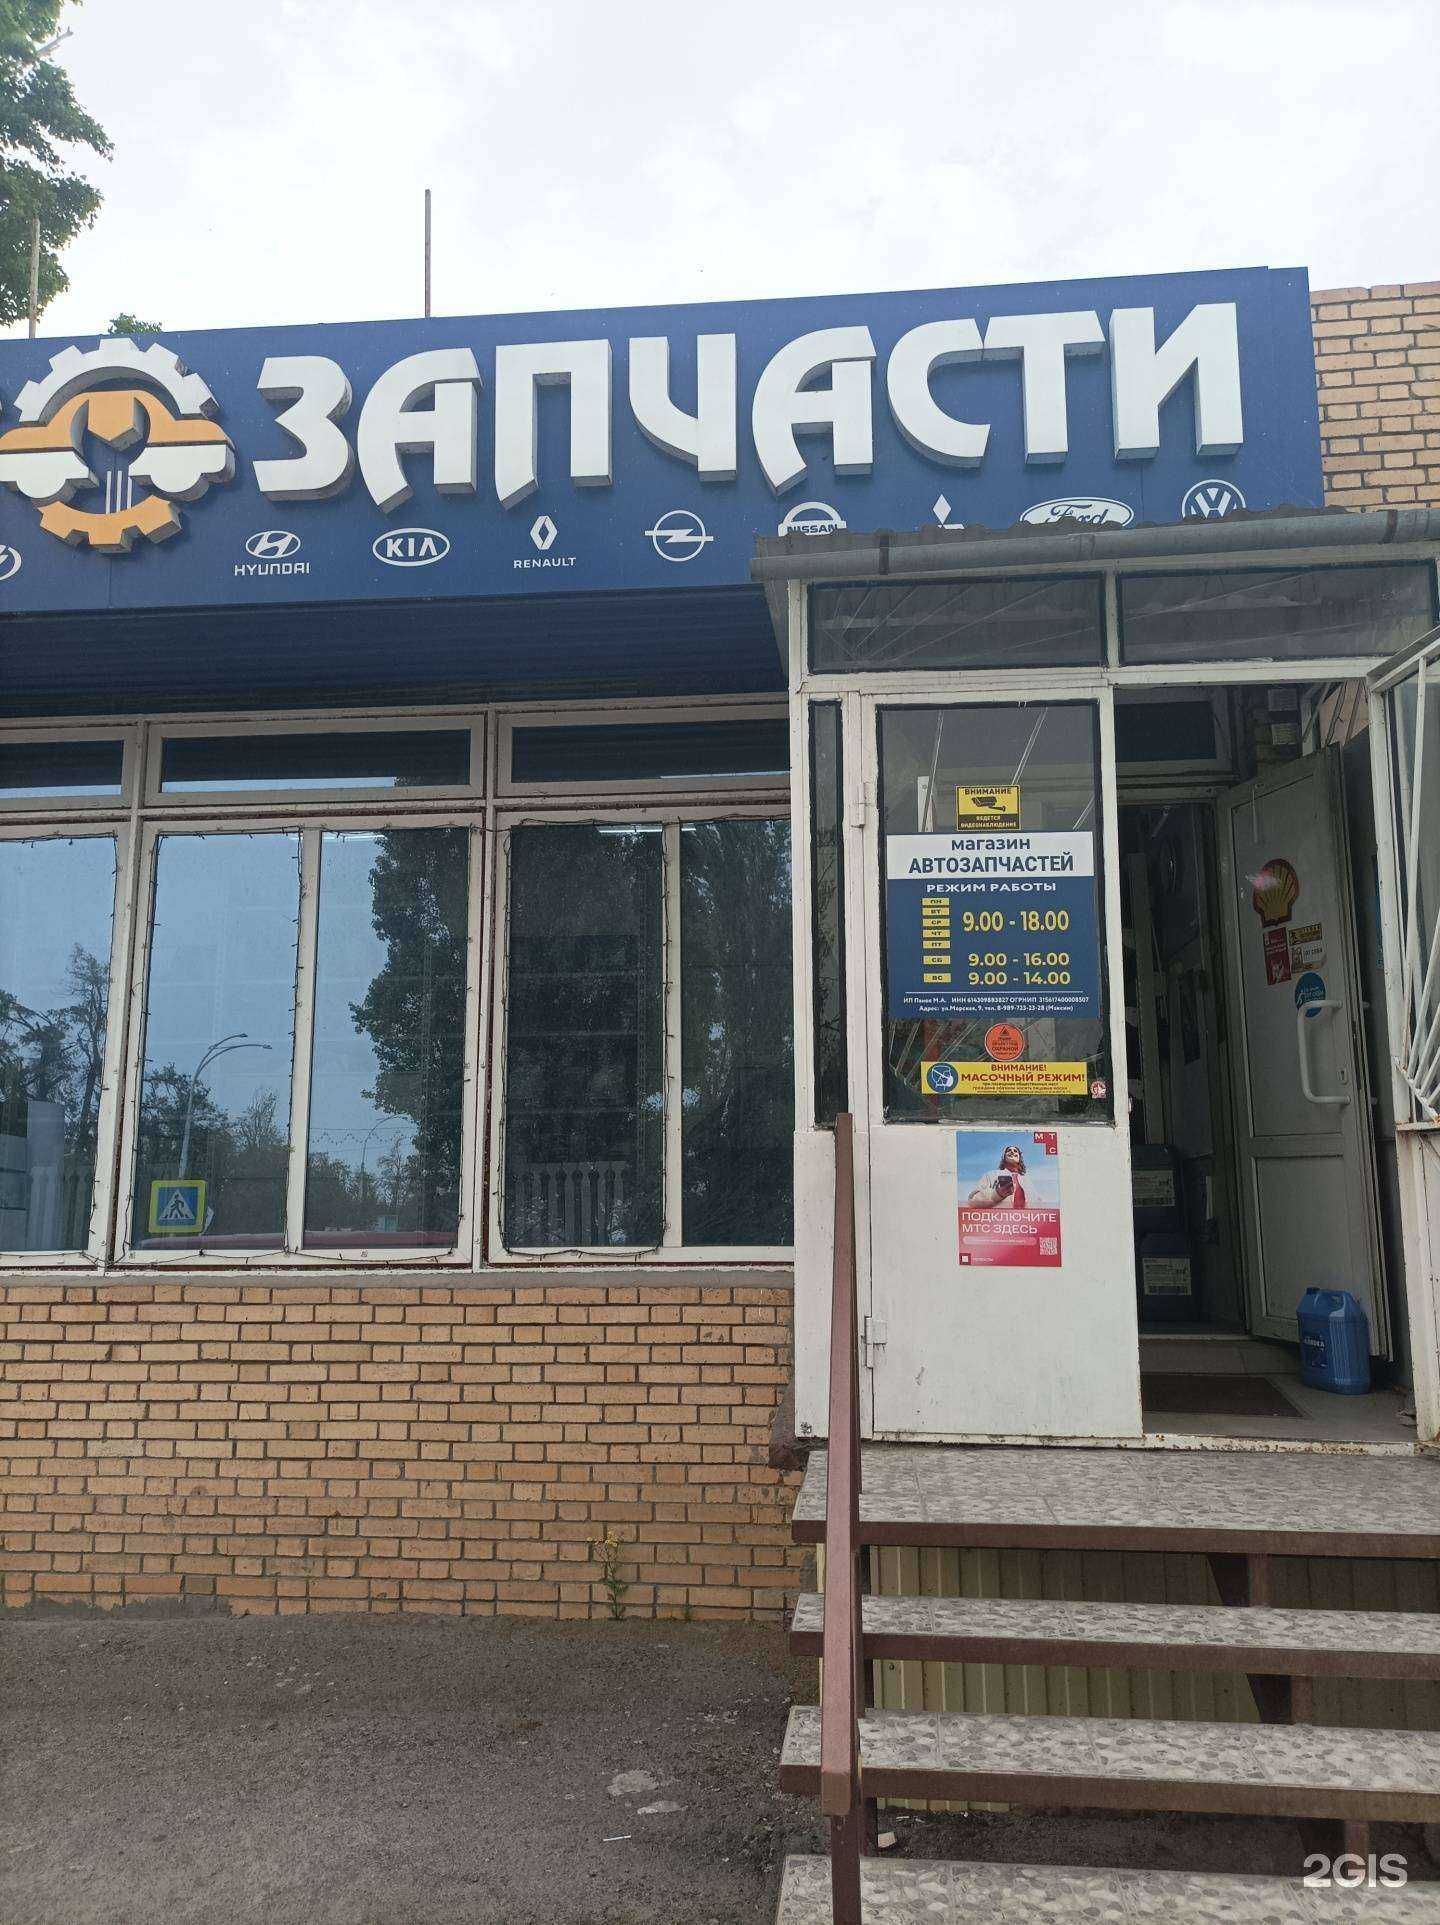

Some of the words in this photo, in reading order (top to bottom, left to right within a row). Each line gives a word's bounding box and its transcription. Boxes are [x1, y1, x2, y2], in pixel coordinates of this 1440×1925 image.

[252, 302, 1244, 508] ЗАПЧАСТИ
[386, 537, 438, 558] KIA
[513, 557, 576, 569] RENAULT
[234, 562, 310, 577] HYUNDAI
[964, 788, 1012, 796] ВНИМАНИЕ
[951, 838, 1031, 850] магазин
[908, 851, 1074, 874] АВТОЗАПЧАСТЕЙ
[926, 883, 986, 893] РЕЖИМ
[990, 882, 1057, 892] РАБОТЫ
[962, 911, 1004, 932] 9.00
[1020, 910, 1070, 931] 18.00
[968, 953, 1008, 967] 9.00
[1023, 952, 1070, 966] 16.00
[968, 972, 1008, 985] 9.00
[1023, 971, 1071, 985] 14.00
[990, 1064, 1047, 1072] ВНИМАНИЕ!
[961, 1071, 1034, 1082] МАСОЧНЫЙ
[1037, 1073, 1085, 1082] РЕЖИМ!
[962, 1211, 1057, 1223] ПОДКЛЮЧИТЕ
[962, 1223, 991, 1233] МТС
[993, 1224, 1038, 1235] ЗДЕСЬ
